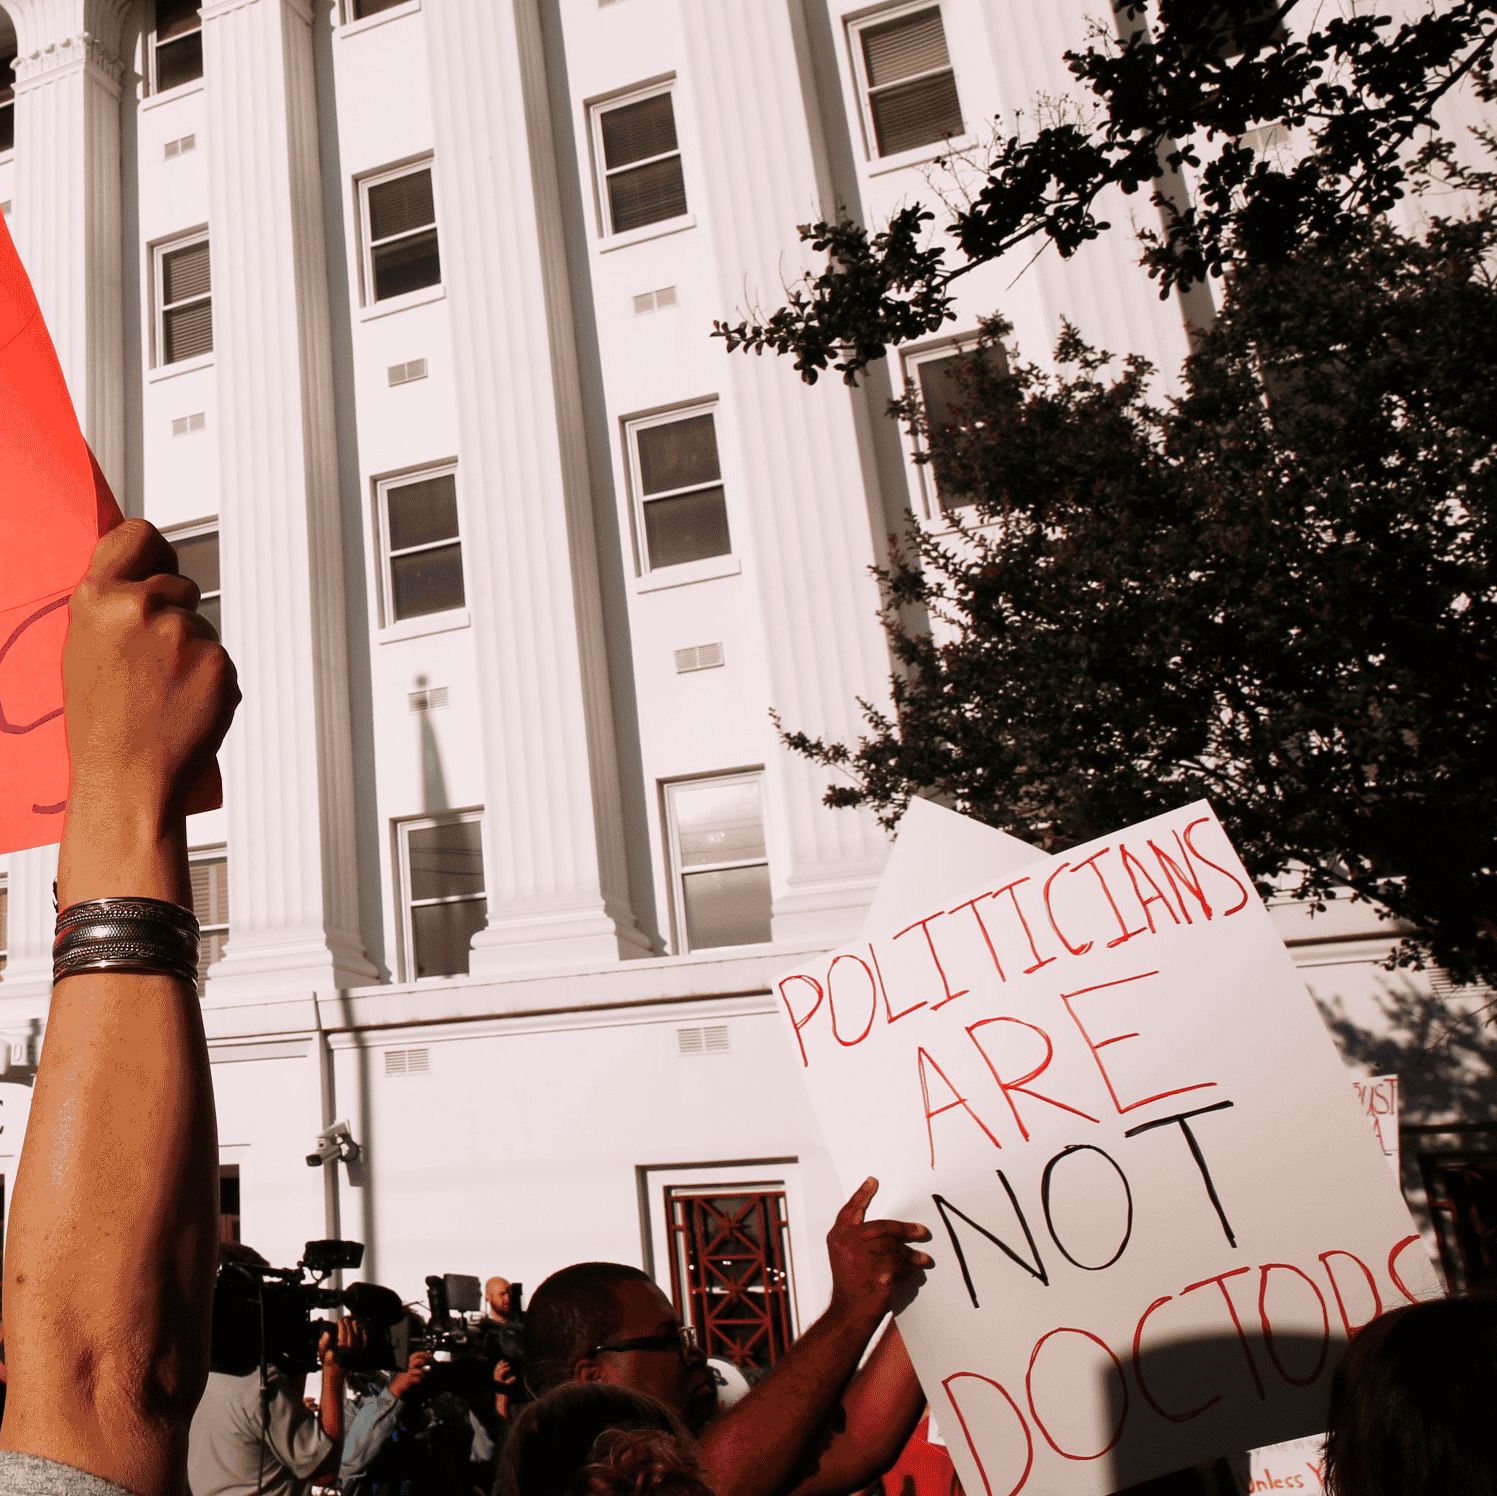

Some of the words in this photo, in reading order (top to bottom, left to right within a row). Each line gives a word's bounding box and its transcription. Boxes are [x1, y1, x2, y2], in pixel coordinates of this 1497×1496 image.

[778, 816, 1249, 1068] POLITICIANS
[915, 970, 1218, 1170] ARE
[931, 1101, 1235, 1309] NOT
